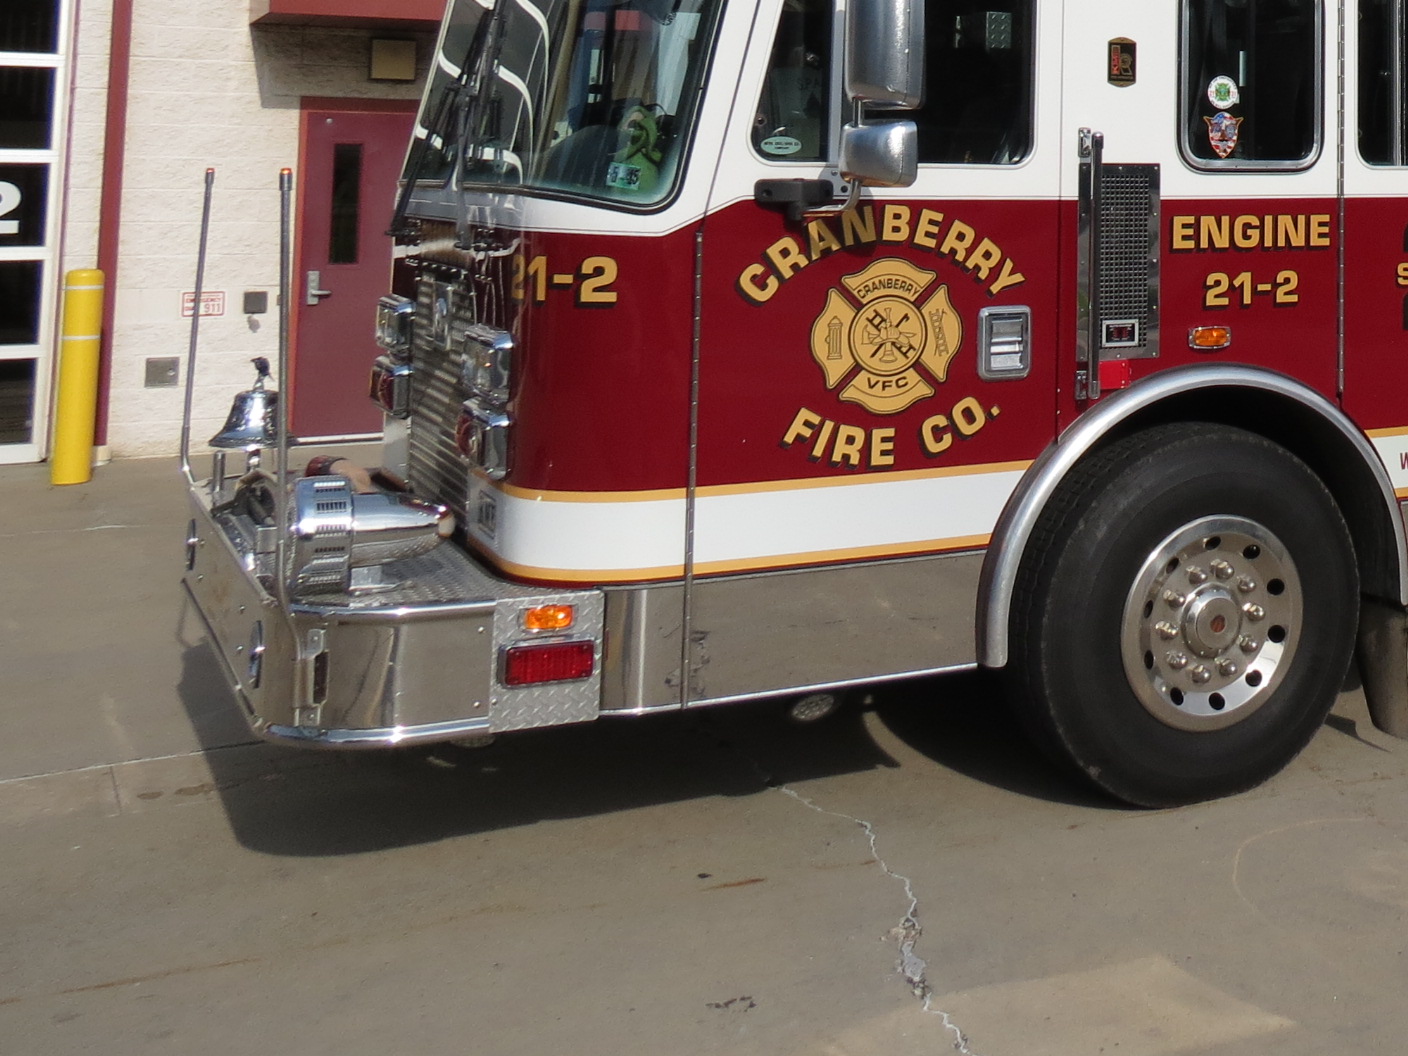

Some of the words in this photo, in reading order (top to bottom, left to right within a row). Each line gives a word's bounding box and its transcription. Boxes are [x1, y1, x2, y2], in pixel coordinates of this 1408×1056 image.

[1172, 214, 1331, 250] ENGINE
[738, 203, 1026, 303] CRANBERRY
[511, 254, 618, 303] 21-2
[856, 278, 921, 299] CRANBERRY
[1205, 269, 1299, 306] 21-2
[867, 376, 909, 392] VFC
[783, 407, 896, 467] FIRE
[920, 396, 1001, 454] CO.
